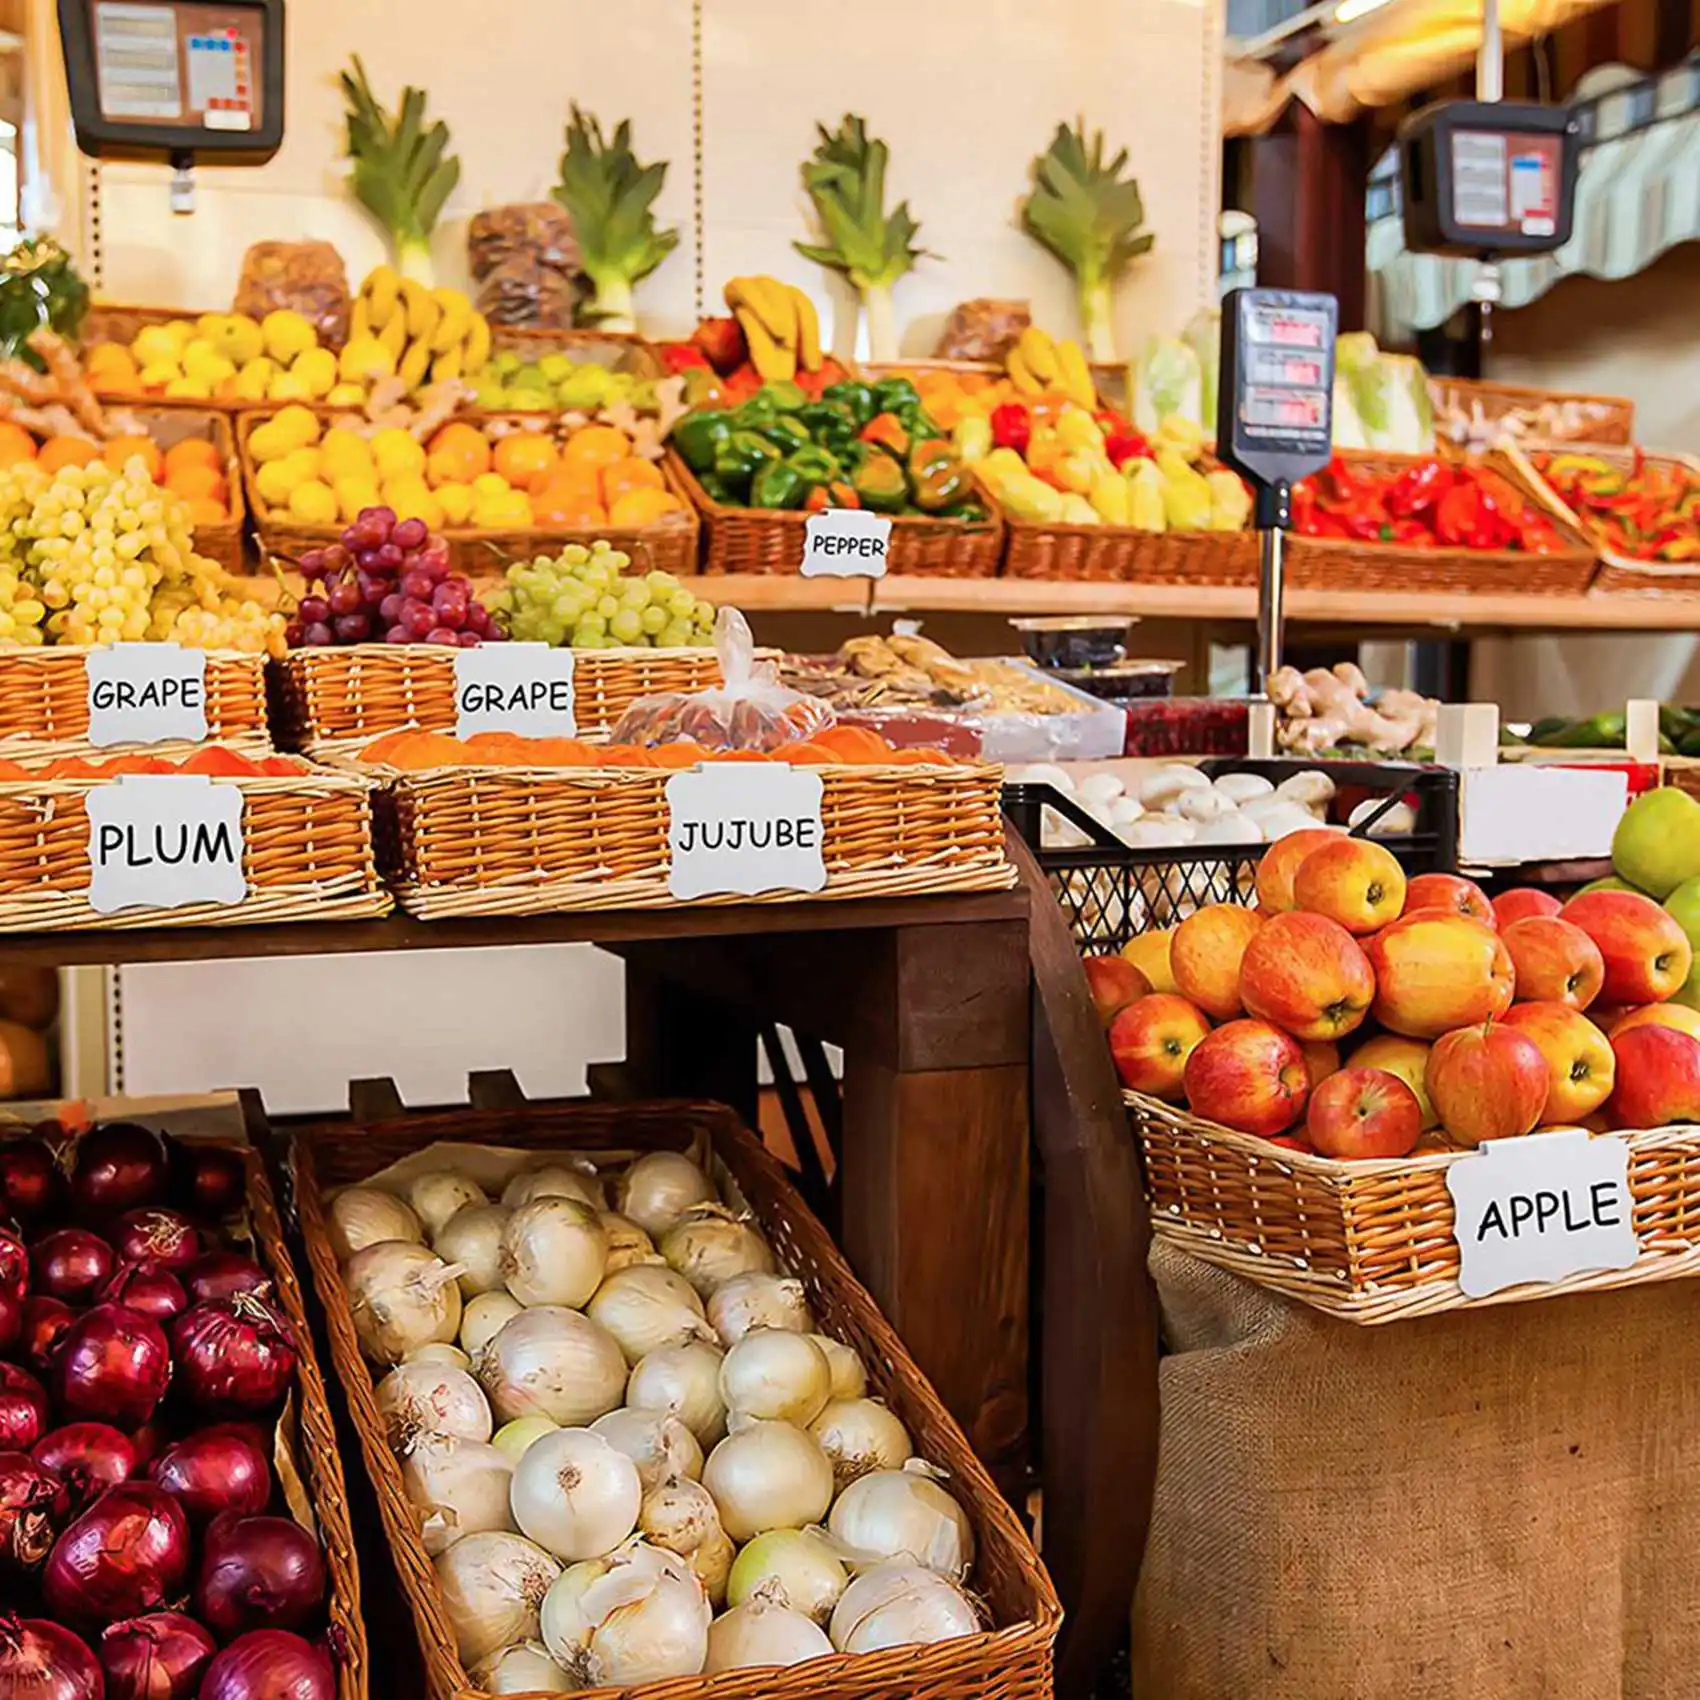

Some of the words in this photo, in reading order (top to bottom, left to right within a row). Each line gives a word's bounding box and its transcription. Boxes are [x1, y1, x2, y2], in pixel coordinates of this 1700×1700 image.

[812, 533, 886, 558] PEPPER
[92, 678, 201, 710] GRAPE
[461, 681, 569, 712] GRAPE
[99, 821, 236, 867] PLUM
[678, 818, 815, 852] JUJUBE
[1477, 1181, 1621, 1242] APPLE
